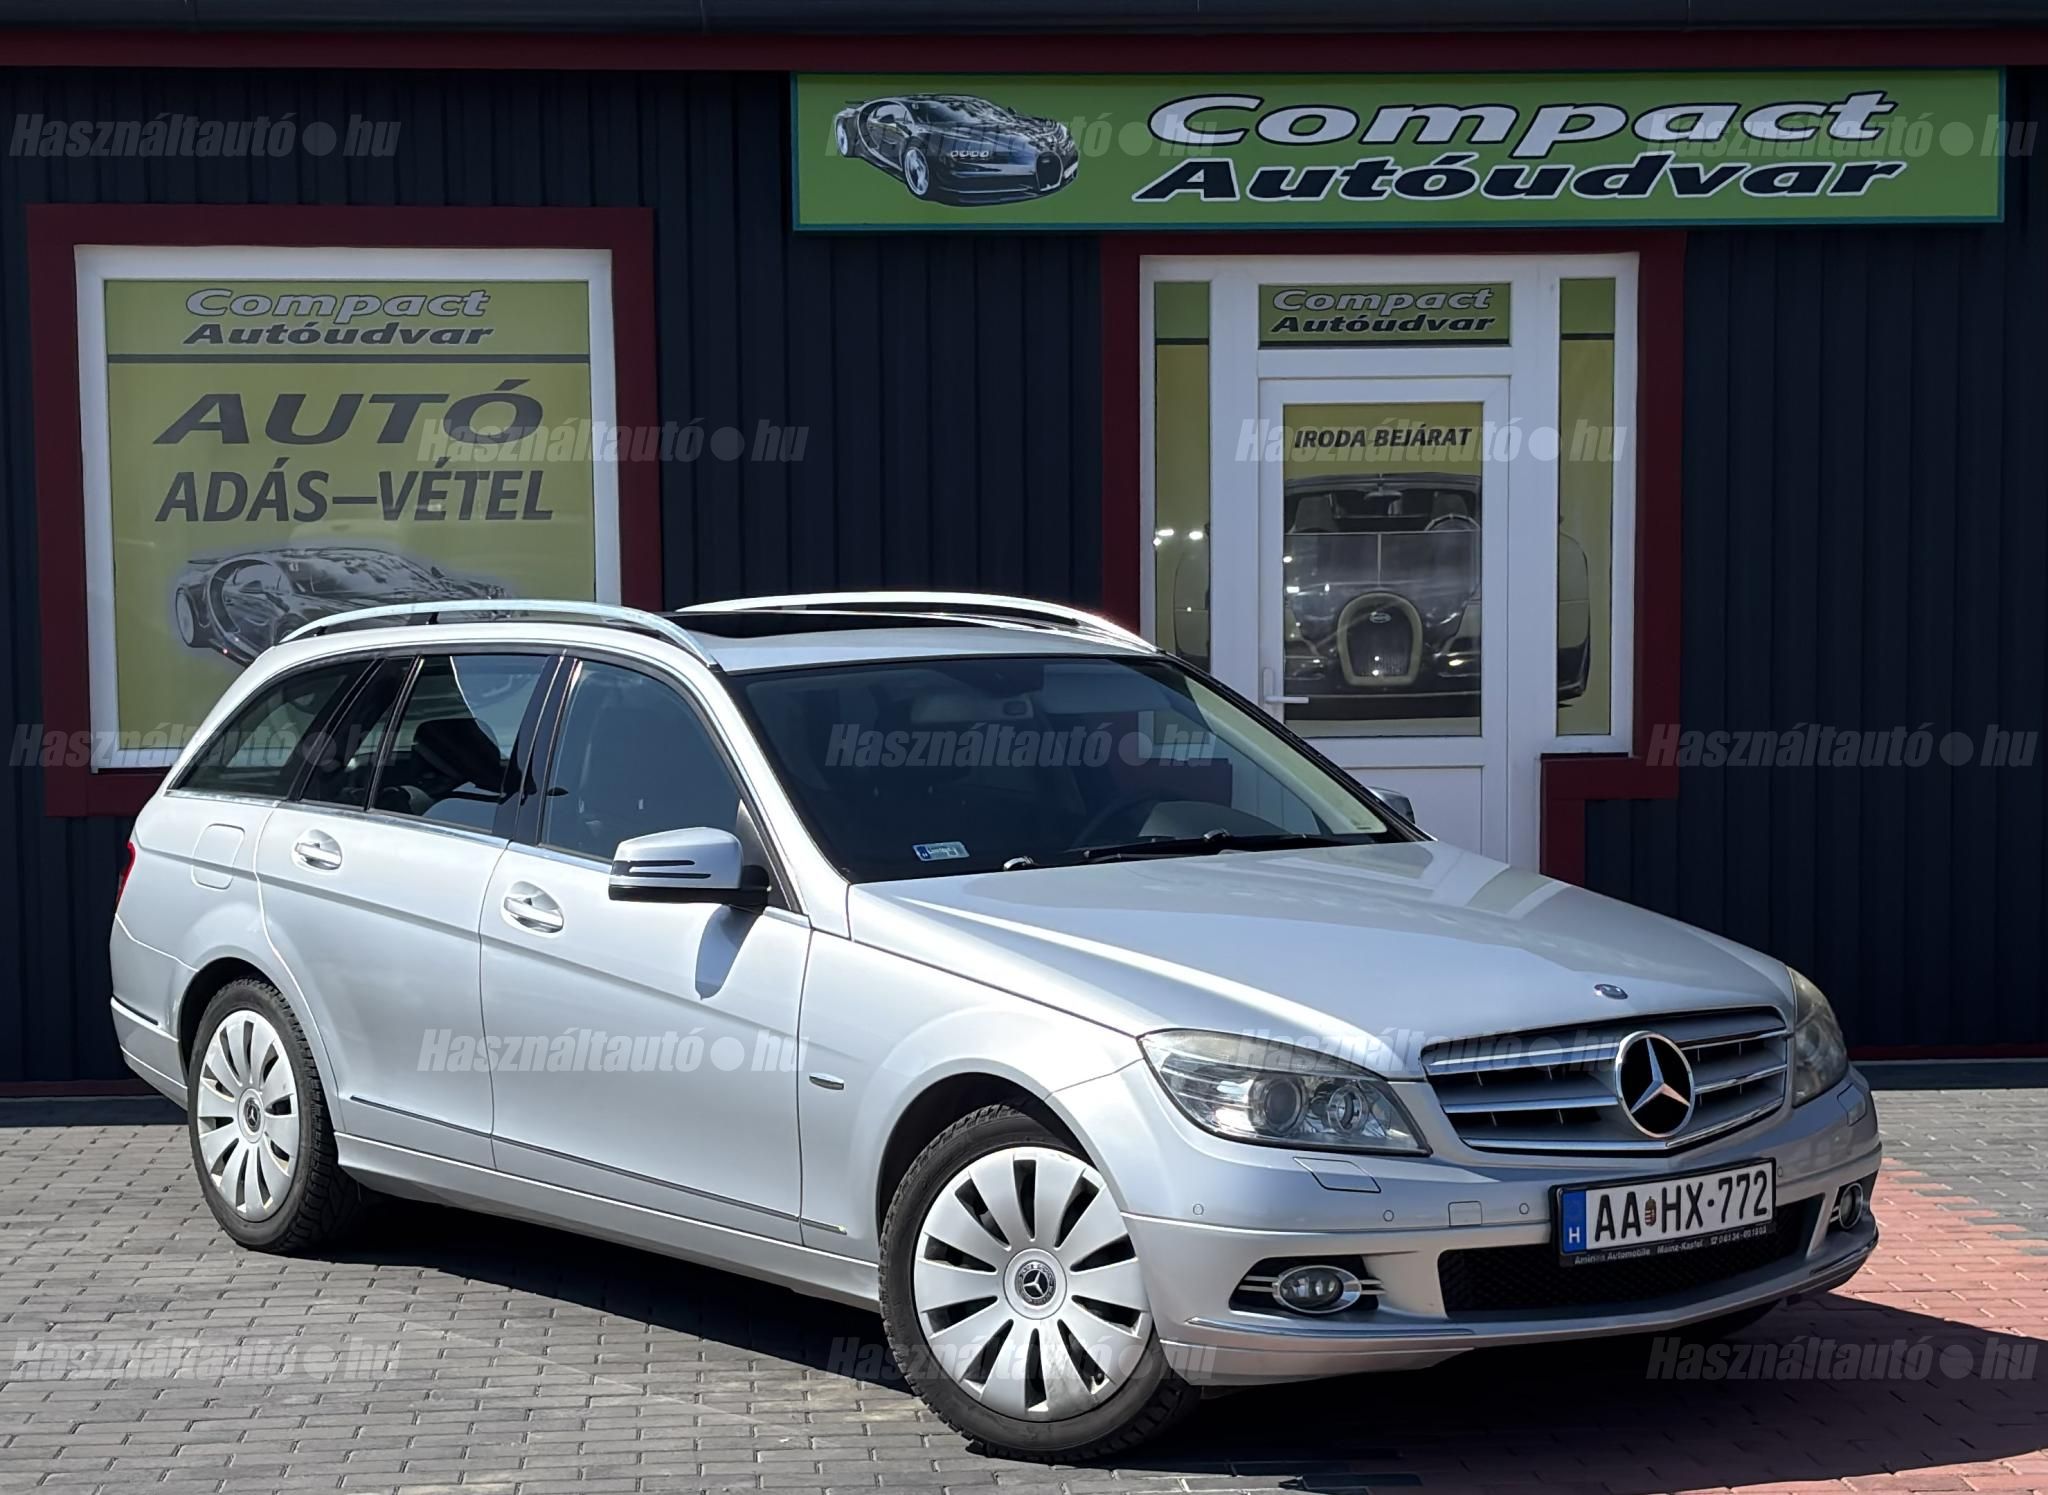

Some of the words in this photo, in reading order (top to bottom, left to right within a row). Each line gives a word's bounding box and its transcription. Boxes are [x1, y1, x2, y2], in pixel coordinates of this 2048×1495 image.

[1147, 90, 1898, 159] Compact
[1132, 151, 1906, 203] Autóudvar
[185, 288, 490, 324] Compact
[1272, 287, 1495, 318] Compact
[182, 320, 494, 346] Autóudvar
[1270, 311, 1496, 335] Autóudvar
[153, 378, 545, 446] AUTÓ
[1294, 429, 1367, 449] IRODA
[1374, 423, 1474, 448] BEJÁRAT
[1594, 1191, 1642, 1242] AA
[1568, 1227, 1581, 1244] H
